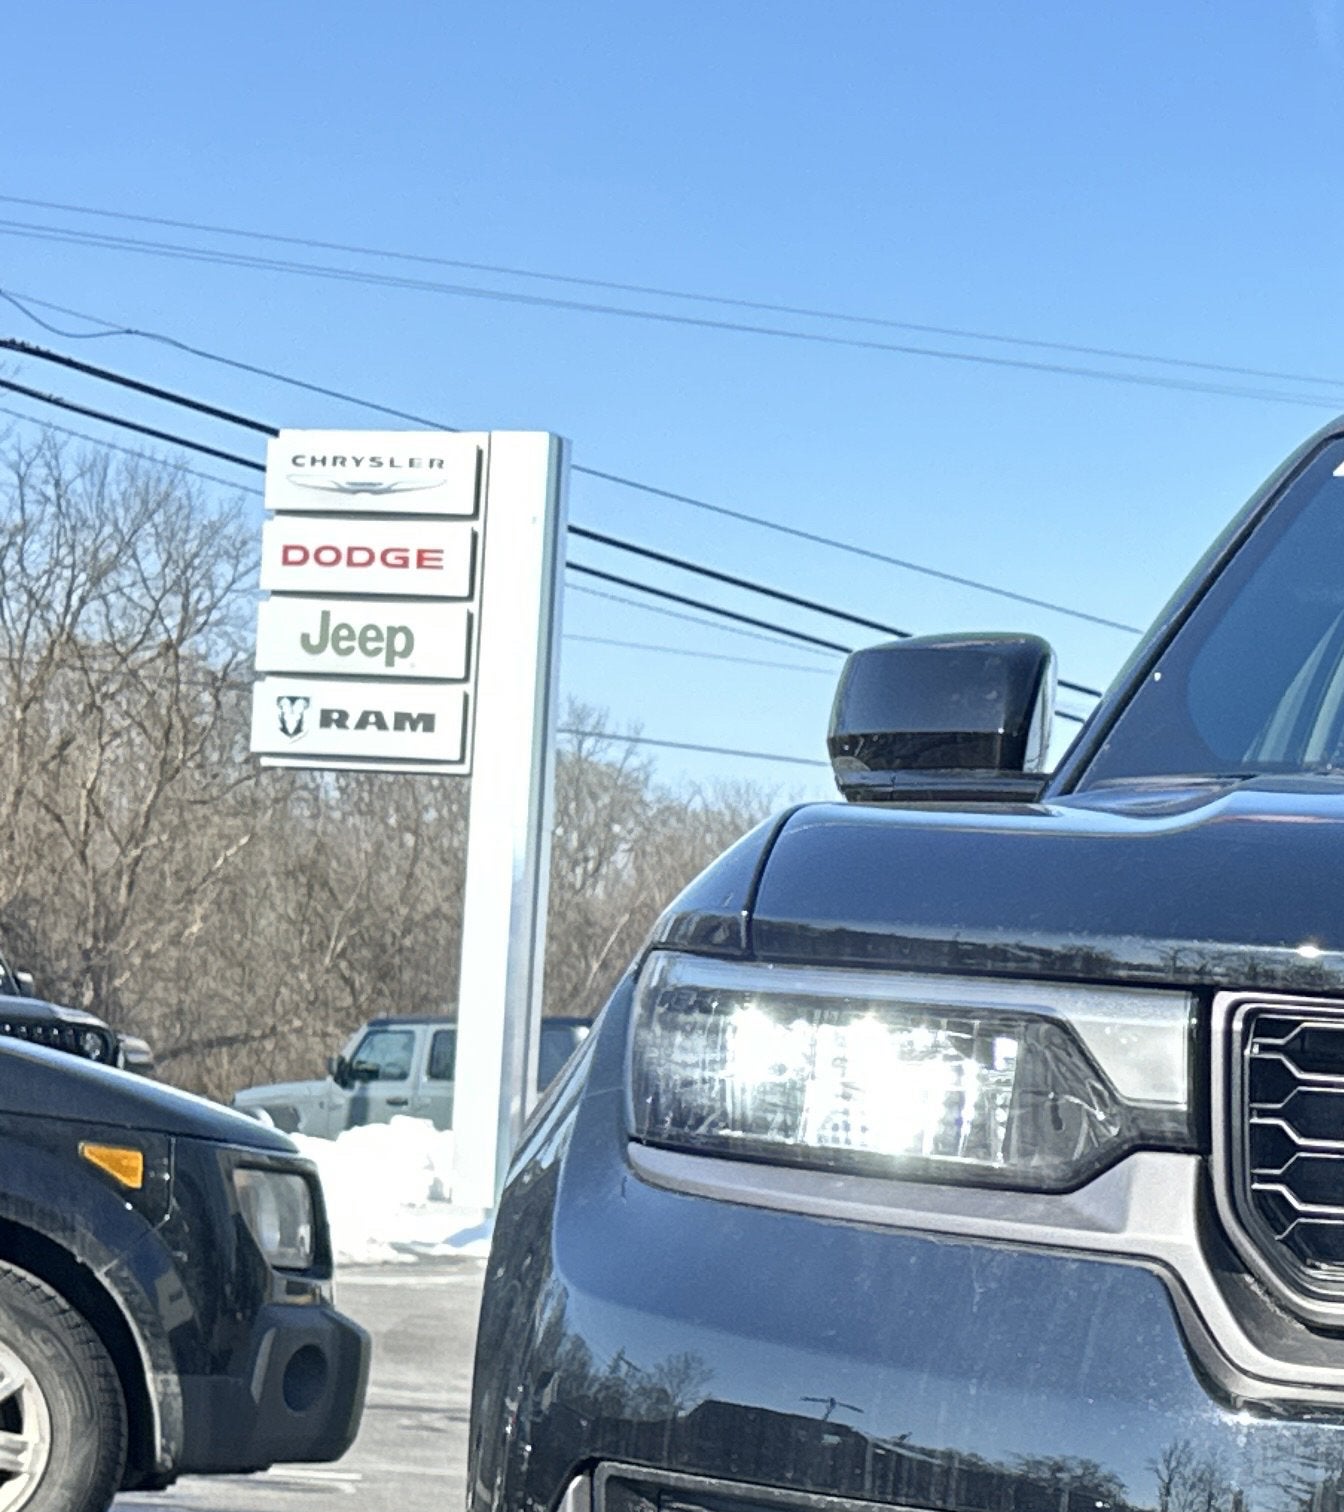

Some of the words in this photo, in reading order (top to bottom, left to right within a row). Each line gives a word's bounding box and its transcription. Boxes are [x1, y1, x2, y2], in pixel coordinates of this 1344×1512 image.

[291, 454, 445, 470] CHRYSLER
[281, 544, 445, 570] DODGE
[300, 610, 415, 668] Jeep
[319, 708, 437, 733] RAM
